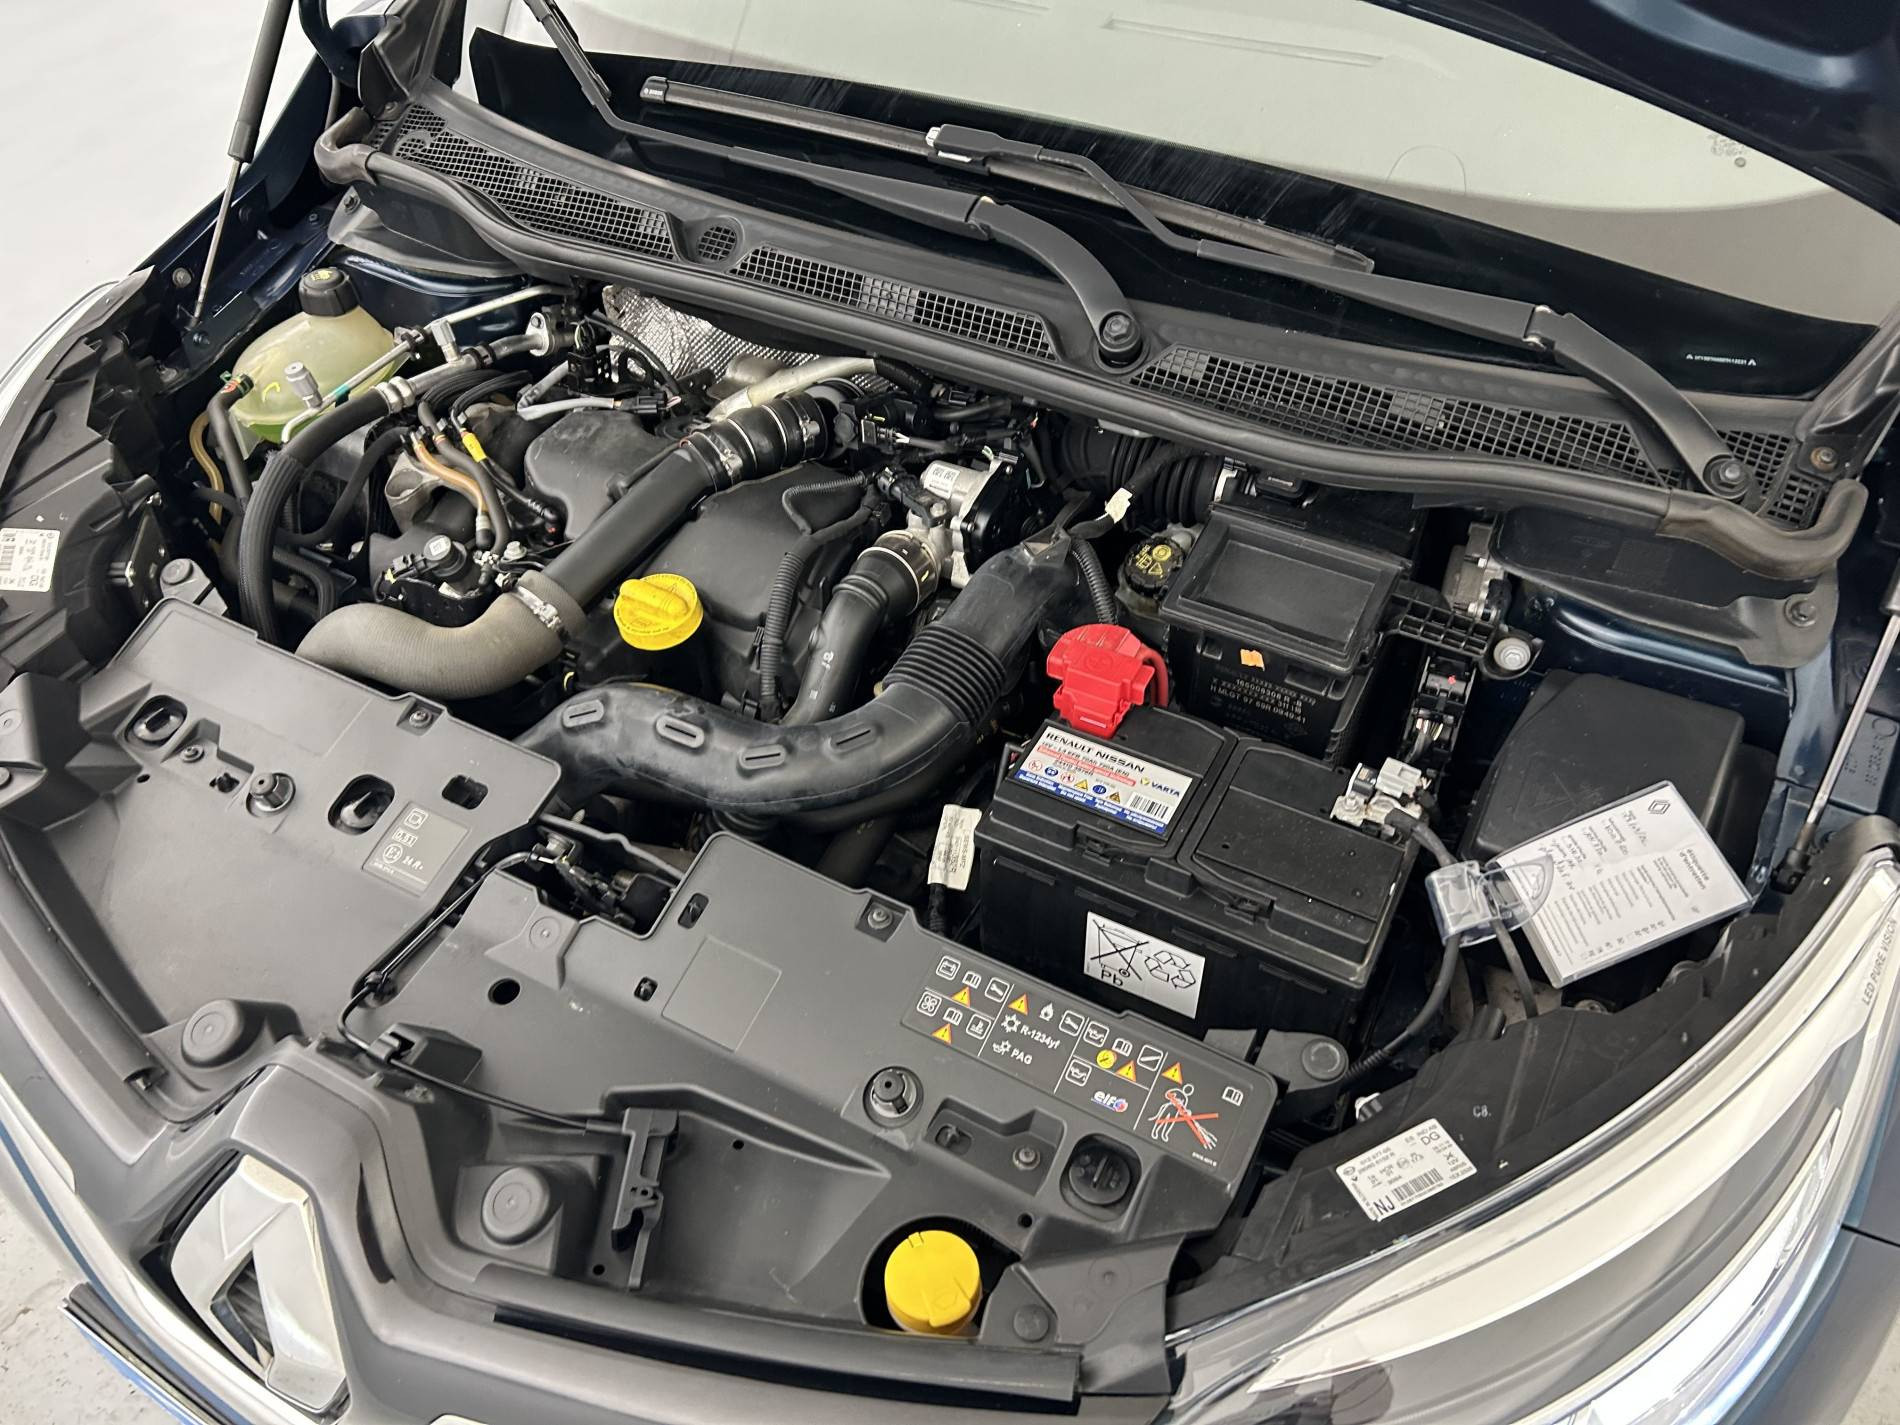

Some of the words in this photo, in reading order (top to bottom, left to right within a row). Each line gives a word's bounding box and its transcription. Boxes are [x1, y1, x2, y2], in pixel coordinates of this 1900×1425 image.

[1046, 733, 1092, 755] RENAULT
[1096, 751, 1145, 773] NISSAN
[1152, 783, 1180, 797] VARTA
[1862, 982, 1875, 1006] LED
[1871, 951, 1886, 983] PURE
[1881, 917, 1897, 952] VISION
[1101, 969, 1123, 987] Pb
[1020, 1025, 1061, 1050] R-1234yf
[1011, 1048, 1033, 1065] PAG
[1094, 1091, 1117, 1106] elf
[1421, 1131, 1440, 1146] DG
[1373, 1195, 1395, 1215] NJ
